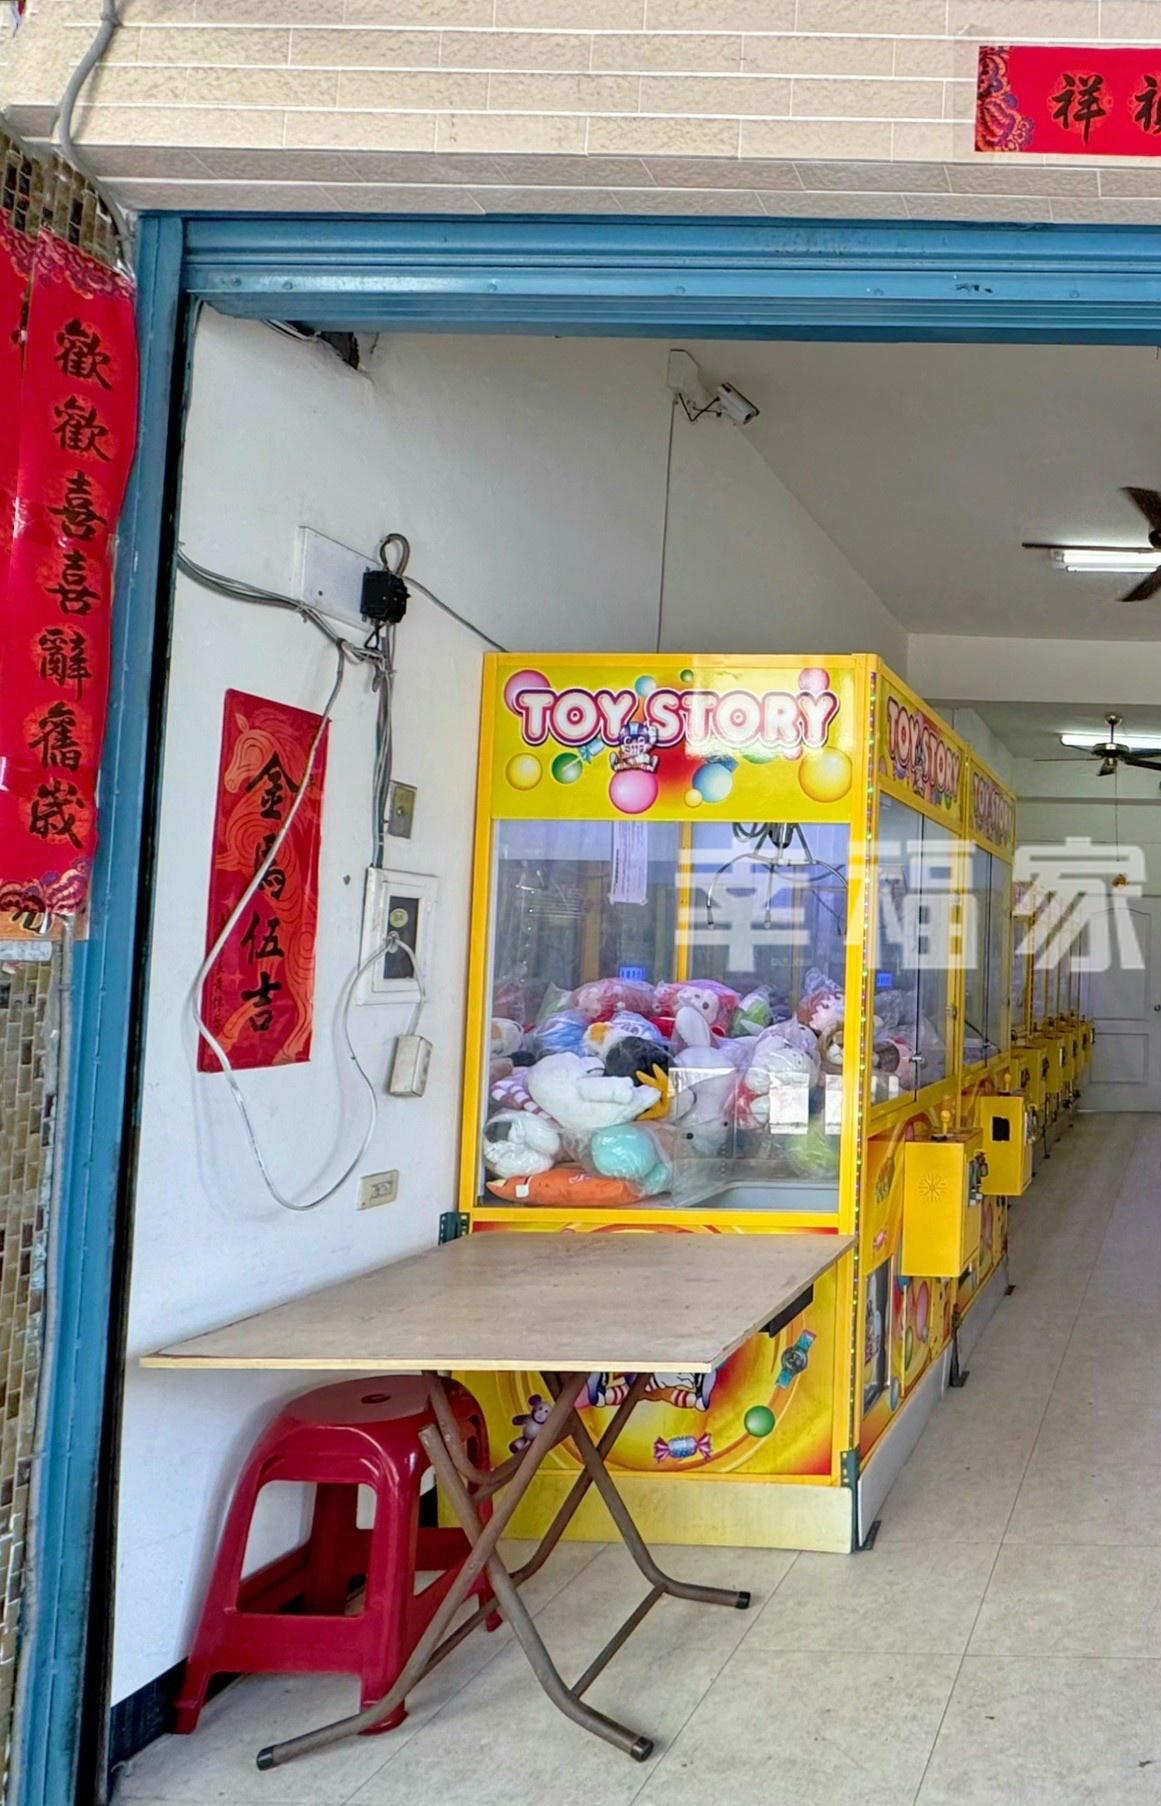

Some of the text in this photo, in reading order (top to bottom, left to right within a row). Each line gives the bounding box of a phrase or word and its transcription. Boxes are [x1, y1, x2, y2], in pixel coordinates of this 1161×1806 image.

[515, 687, 840, 750] TOY STORY
[886, 694, 962, 803] TOY STORY
[240, 751, 300, 1033] 金馬伍吉
